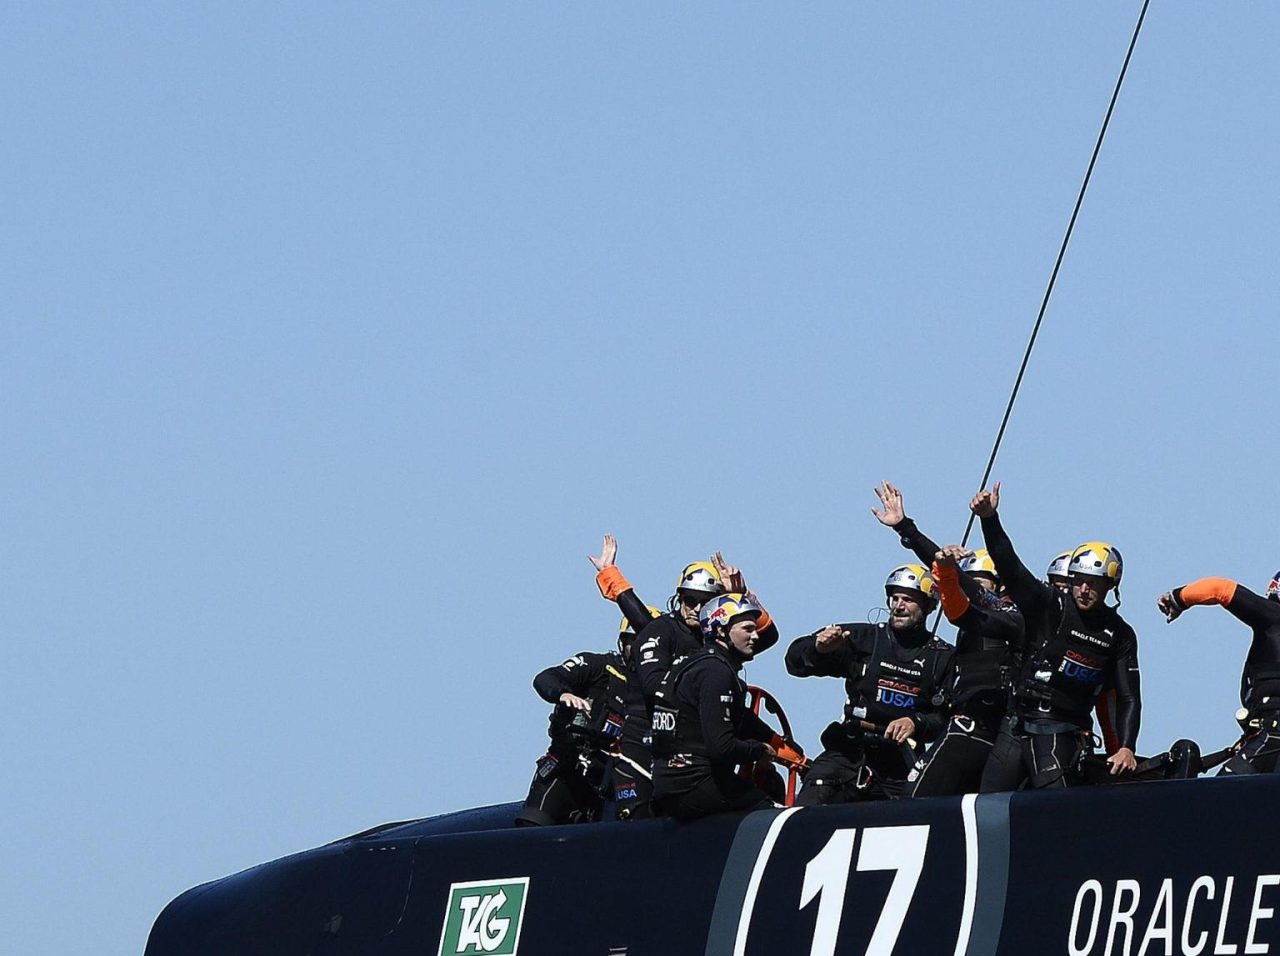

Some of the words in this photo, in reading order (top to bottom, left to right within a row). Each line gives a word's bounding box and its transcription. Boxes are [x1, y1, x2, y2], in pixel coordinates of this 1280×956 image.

[878, 678, 922, 694] ORACLE
[881, 689, 915, 708] USA
[616, 788, 638, 800] USA
[455, 888, 511, 953] TAG
